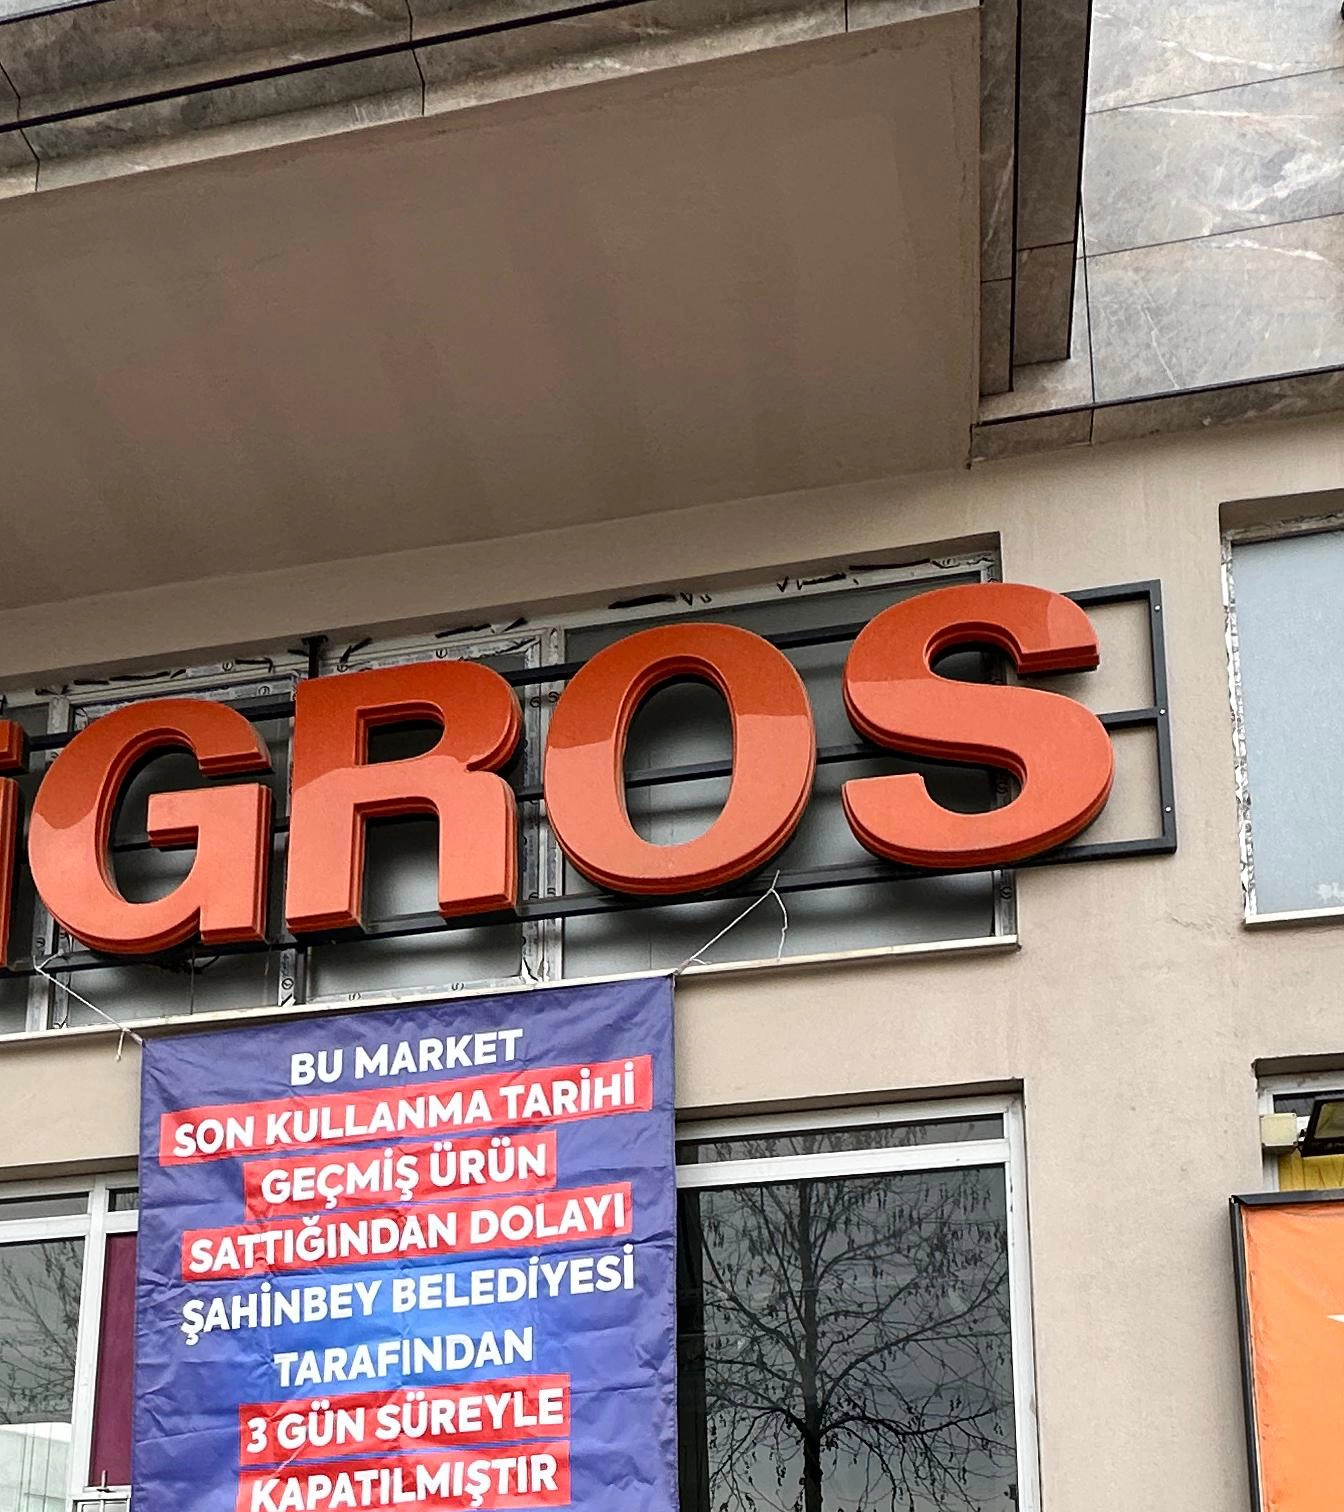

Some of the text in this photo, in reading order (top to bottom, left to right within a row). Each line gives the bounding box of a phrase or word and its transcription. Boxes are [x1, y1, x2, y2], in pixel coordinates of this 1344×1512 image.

[290, 1028, 524, 1087] BU MARKET
[174, 1061, 636, 1157] SON KULLANMA TARİHİ
[260, 1138, 547, 1206] GEÇMİŞ ÜRÜN
[189, 1191, 626, 1273] SATTIĞINDAN DOLAYI
[181, 1244, 636, 1346] ŞAHİNBEY BELEDİYESİ
[274, 1326, 534, 1388] TARAFINDAN
[246, 1387, 565, 1453] 3 GÜN SÜREYLE
